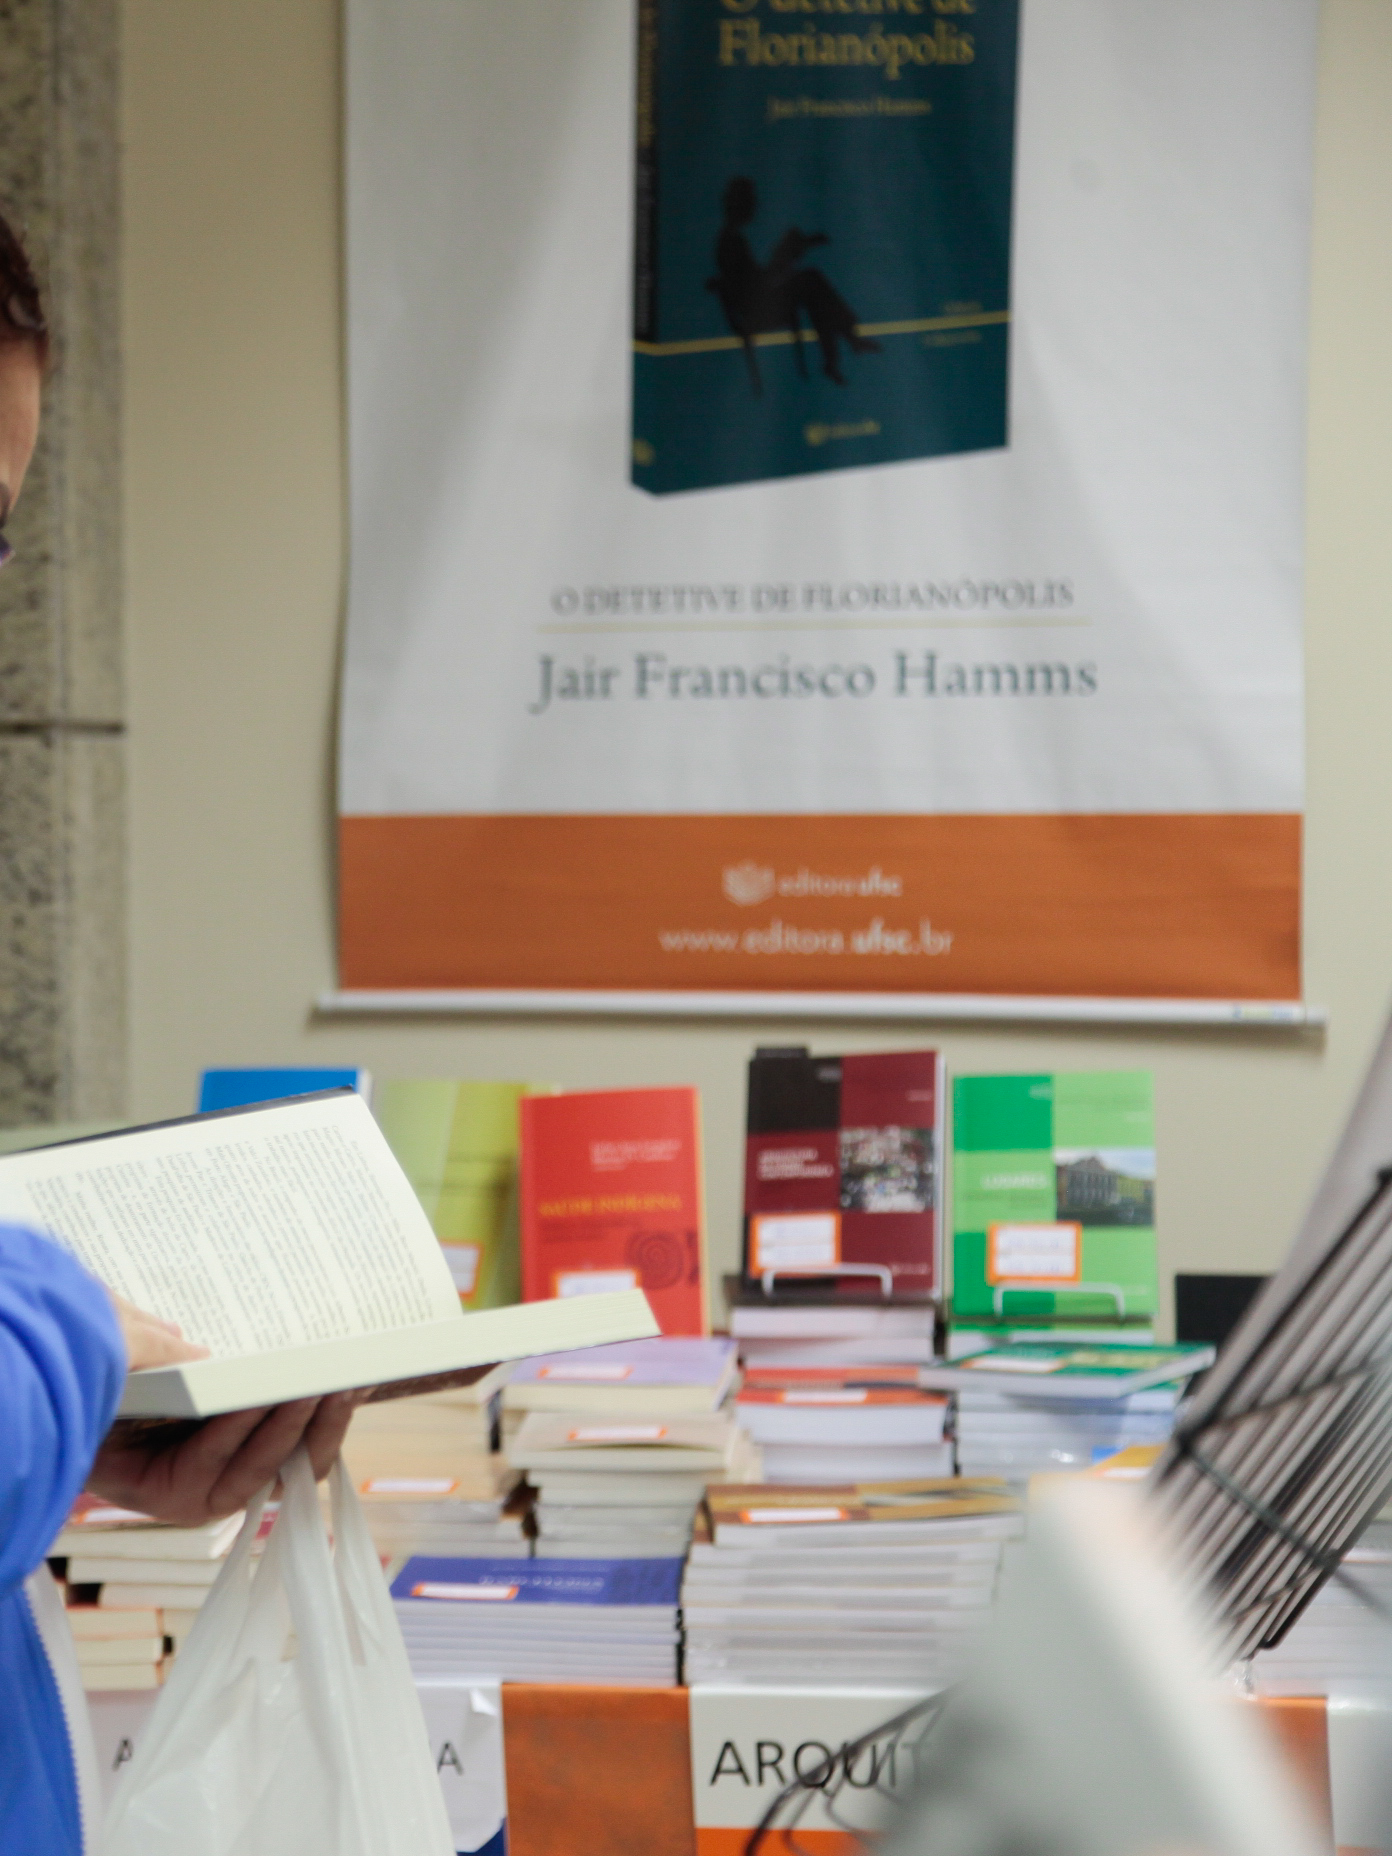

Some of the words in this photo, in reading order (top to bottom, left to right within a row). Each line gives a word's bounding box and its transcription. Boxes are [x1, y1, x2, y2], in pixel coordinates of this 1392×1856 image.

[550, 583, 579, 617] O
[583, 579, 740, 616] DETETIVE
[750, 579, 790, 612] DE
[800, 575, 1076, 612] FLORIANÓPOLIS
[528, 653, 620, 716] Jair
[632, 651, 877, 701] Francisco
[893, 648, 1101, 699] Hamms
